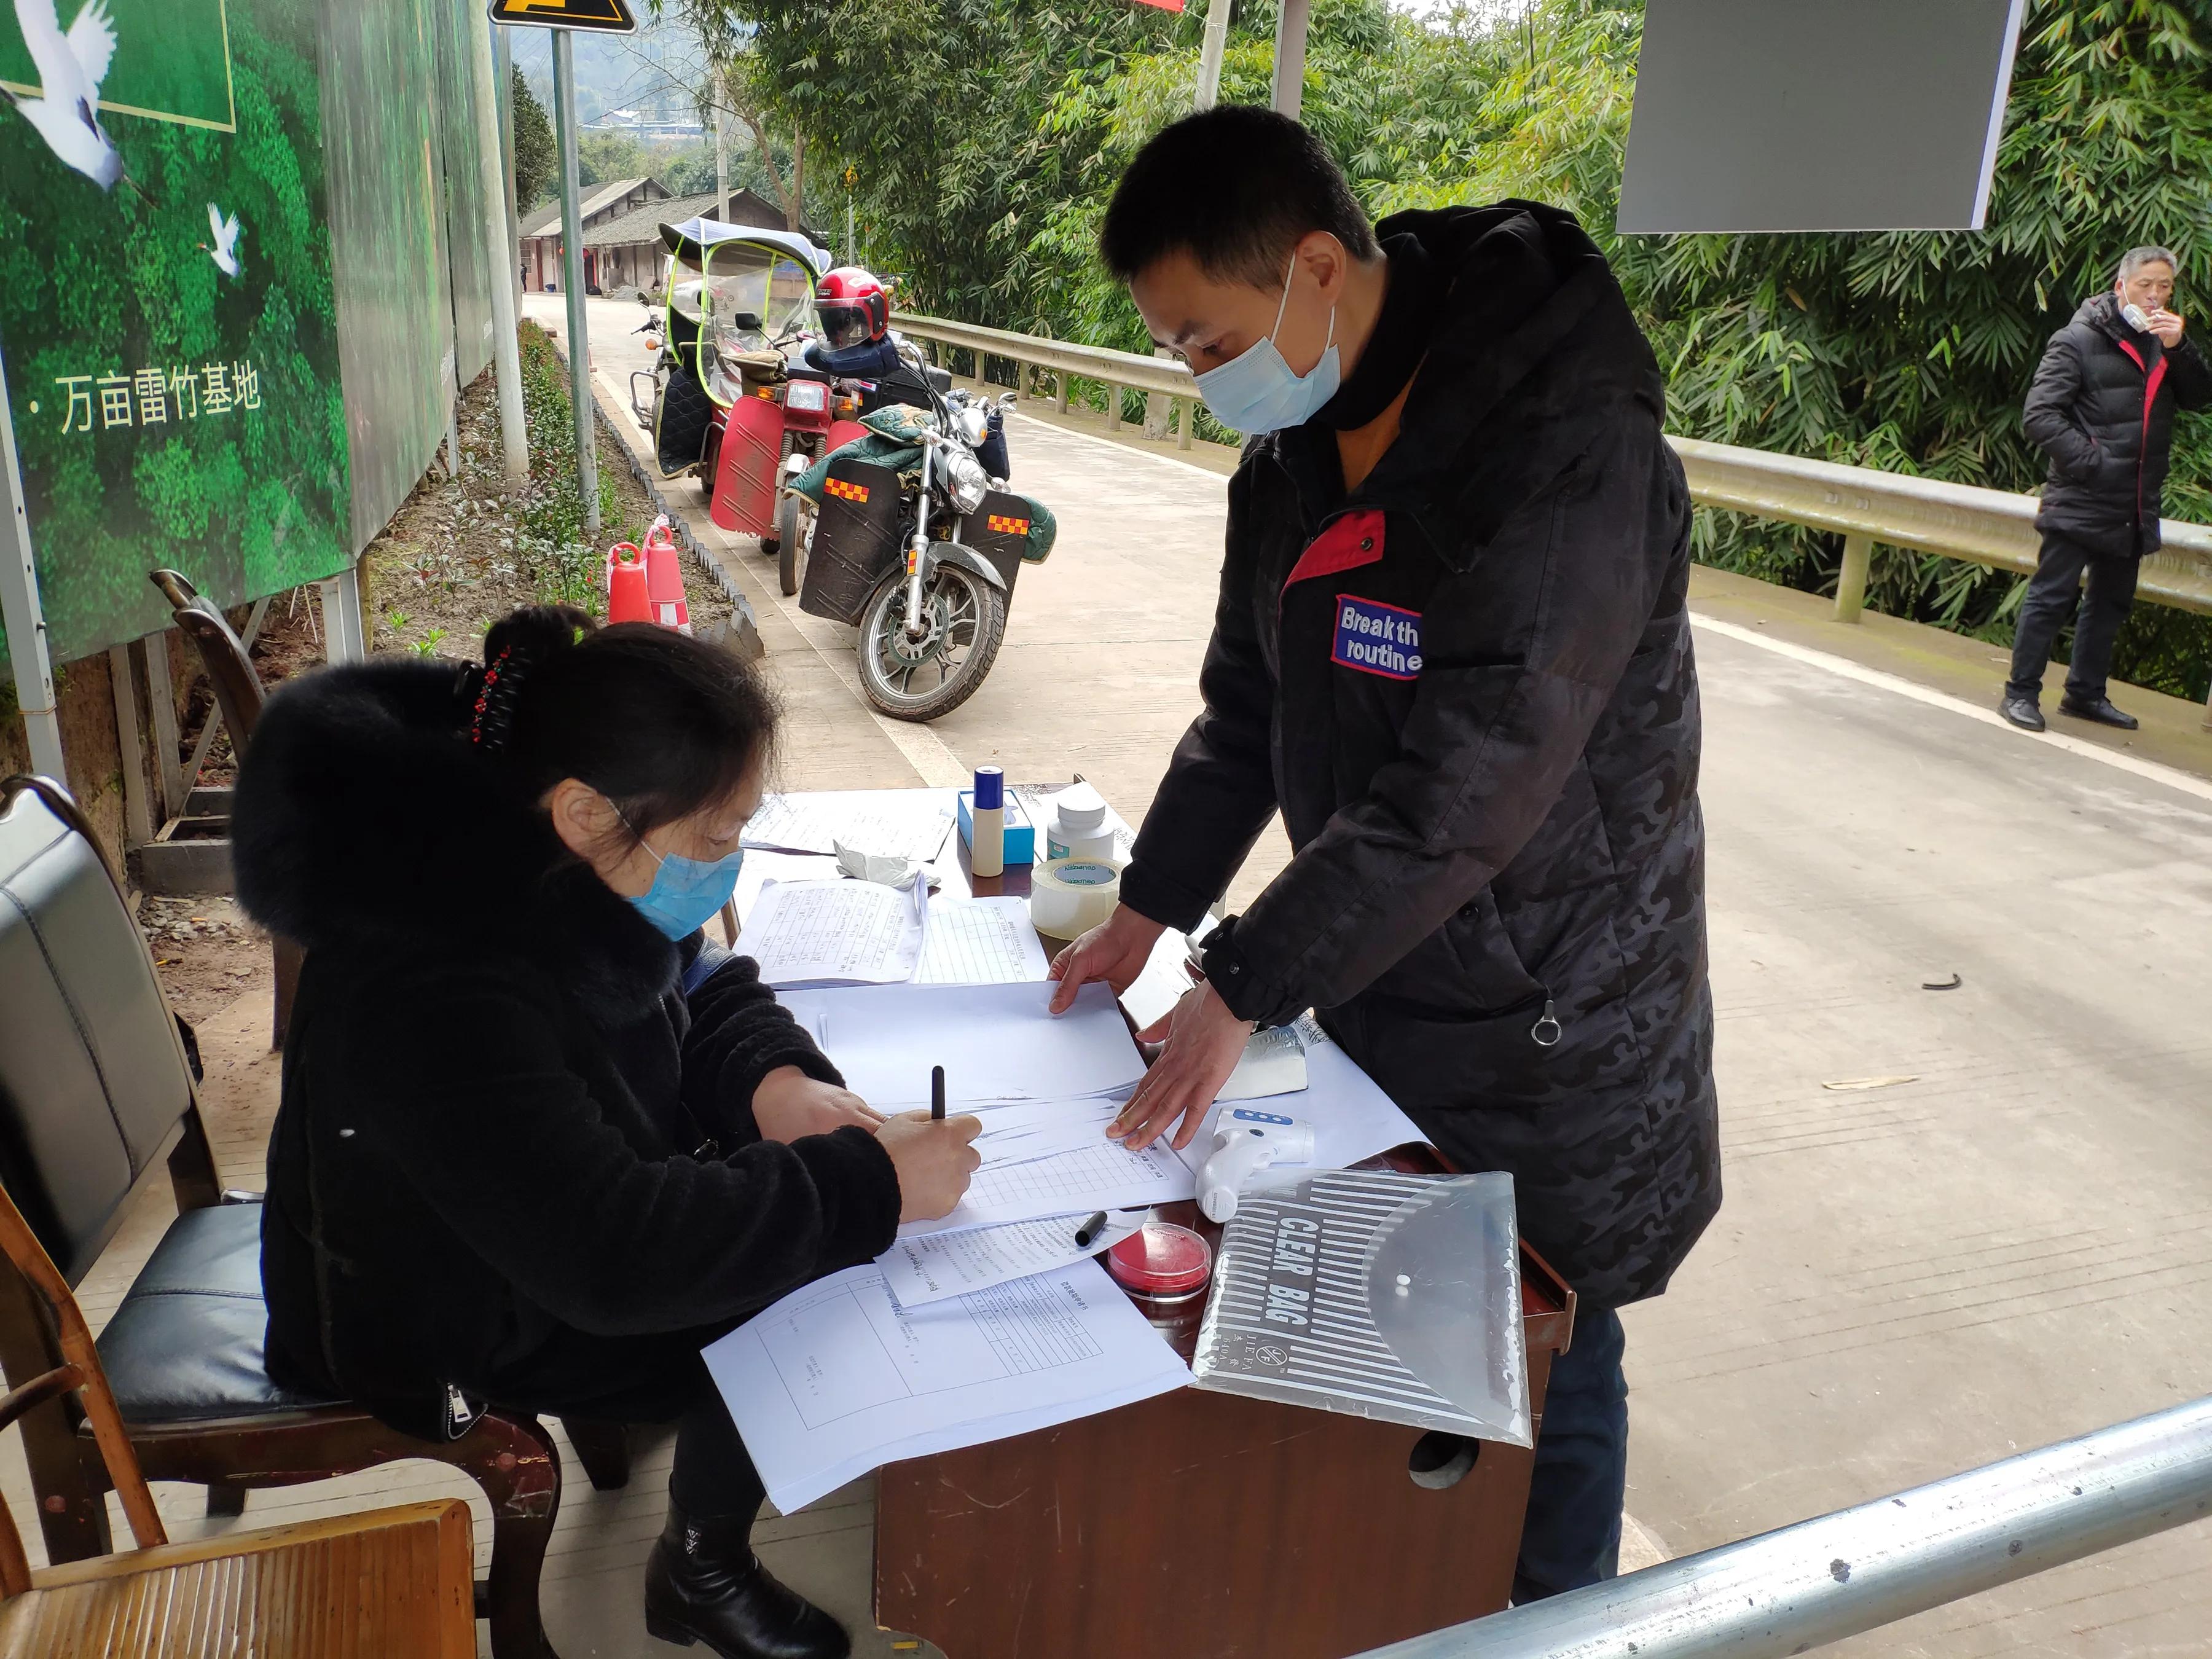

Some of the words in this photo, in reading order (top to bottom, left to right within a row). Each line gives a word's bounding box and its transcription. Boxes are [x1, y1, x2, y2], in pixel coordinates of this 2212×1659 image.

[55, 359, 261, 436] 万亩雷竹基地
[1341, 606, 1395, 641] Break
[1396, 621, 1419, 646] th
[1346, 639, 1423, 672] routine
[1272, 1217, 1320, 1276] CLEAR
[1265, 1283, 1311, 1325] BAG
[1220, 1338, 1230, 1360] 640A
[1245, 1334, 1258, 1354] JIE
[1241, 1357, 1253, 1371] FA
